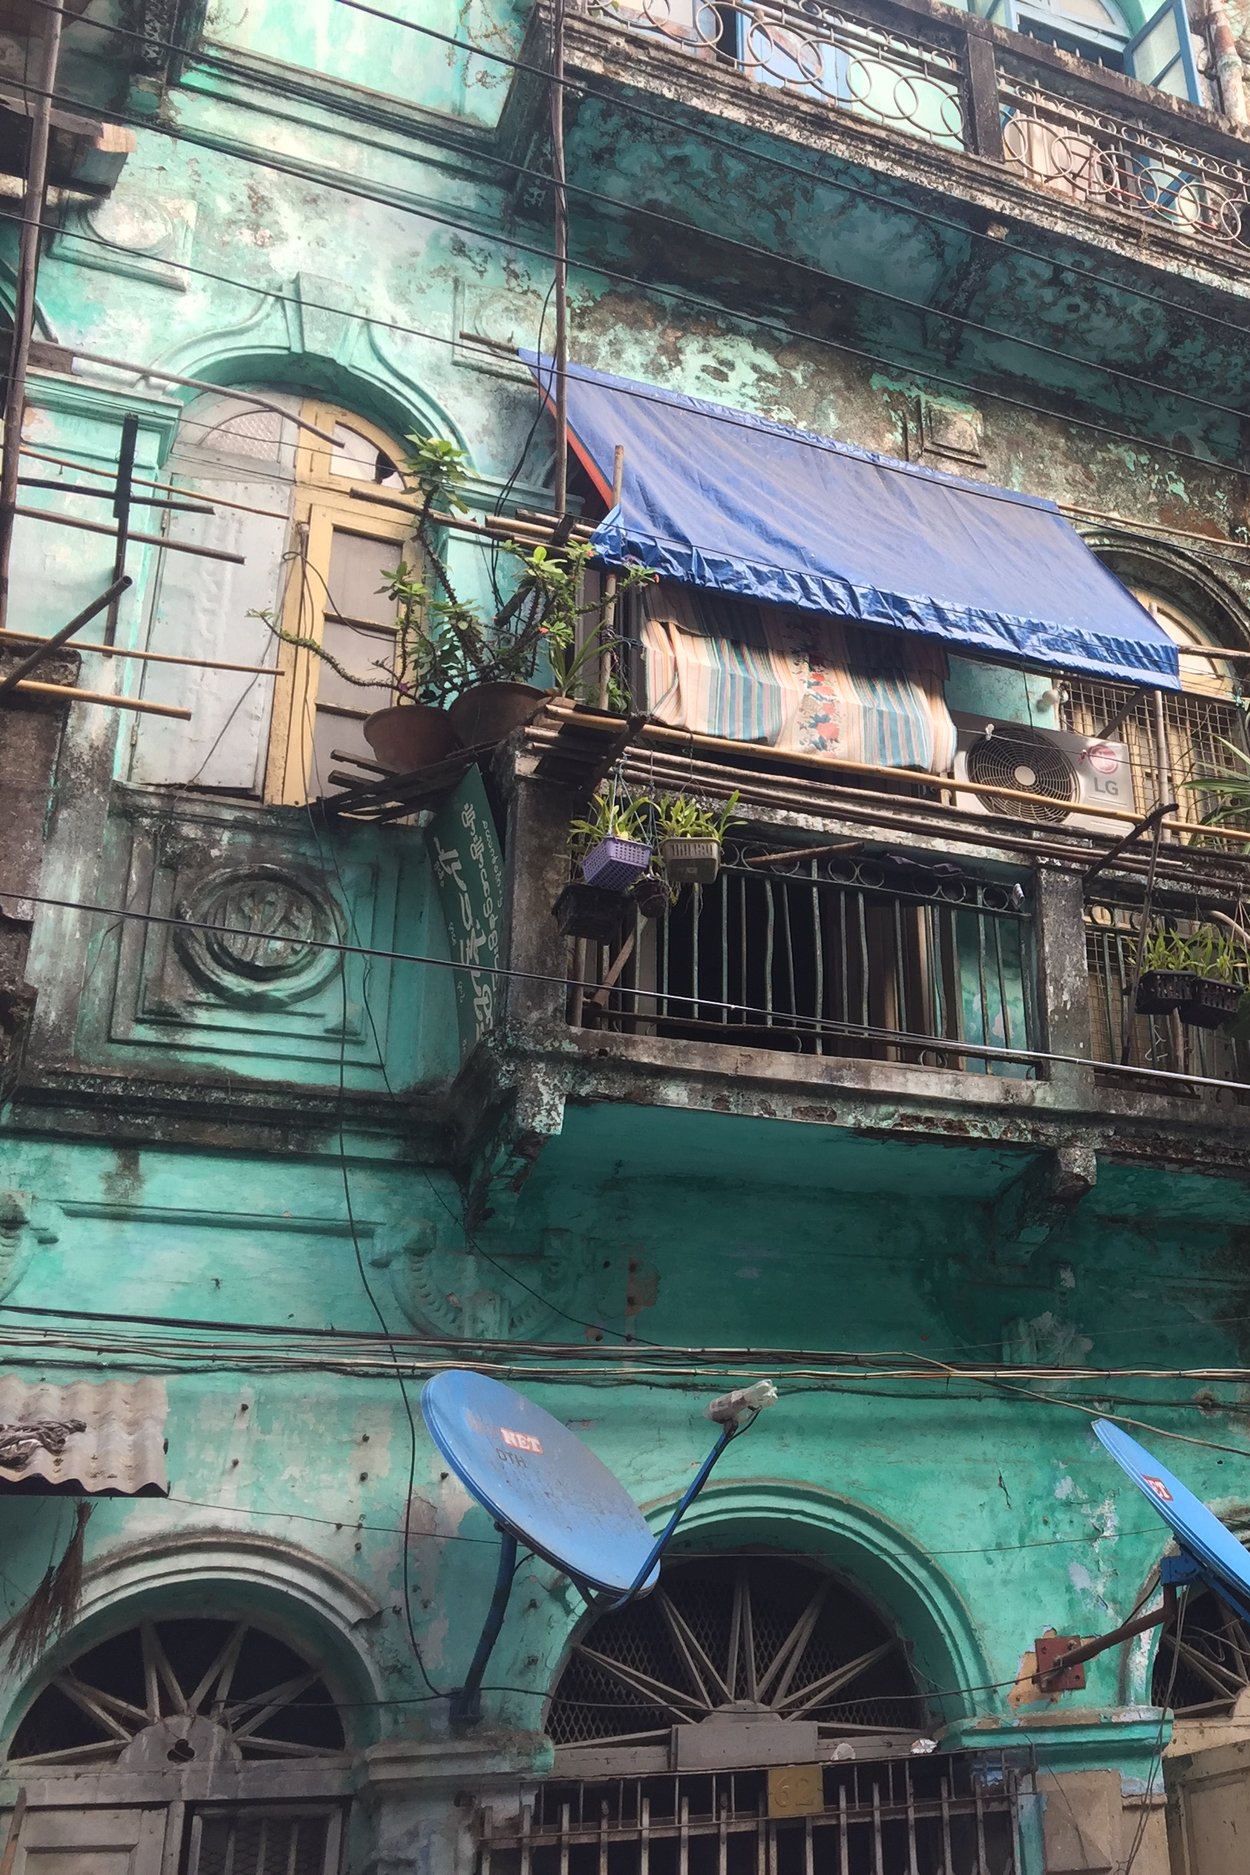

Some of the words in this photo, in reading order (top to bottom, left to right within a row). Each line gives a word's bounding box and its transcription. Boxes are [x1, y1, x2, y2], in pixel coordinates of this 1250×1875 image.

[1094, 778, 1118, 795] LG
[501, 1428, 542, 1454] NET
[496, 1448, 527, 1468] DTH
[775, 1776, 815, 1807] 62
